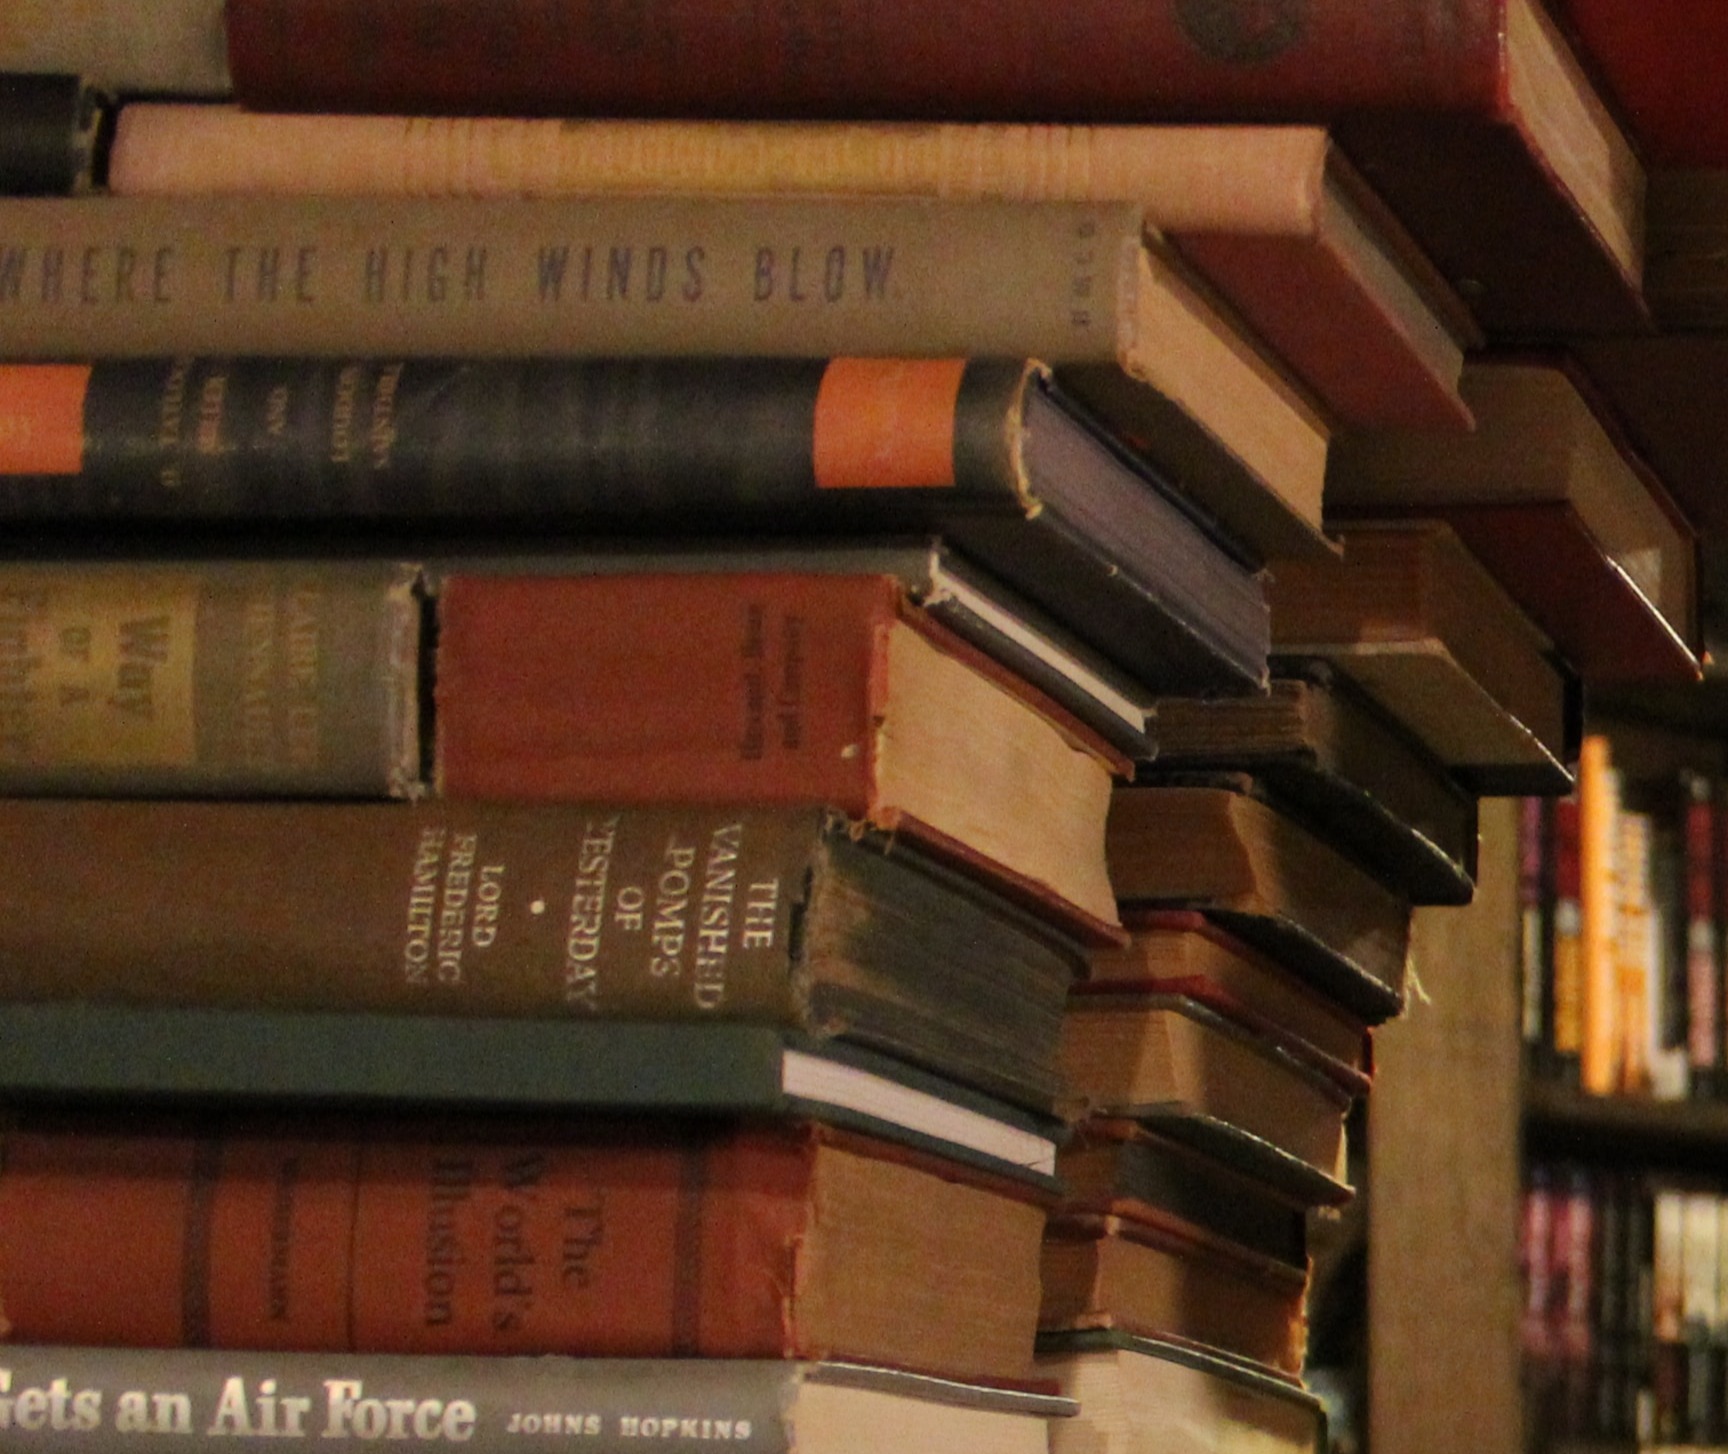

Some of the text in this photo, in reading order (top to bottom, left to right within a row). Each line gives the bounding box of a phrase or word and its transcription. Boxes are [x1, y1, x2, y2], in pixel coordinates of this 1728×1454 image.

[0, 247, 175, 303] WHERE
[225, 247, 318, 303] THE
[364, 247, 488, 303] HIGH
[537, 246, 707, 303] WINDS
[107, 615, 172, 722] Way
[403, 826, 447, 986] HAMILTON
[436, 832, 479, 988] FREDERIC
[471, 864, 506, 949] LORD
[564, 814, 622, 1012] YESTERDAY
[613, 885, 645, 932] OF
[648, 843, 698, 981] POMPS
[692, 821, 745, 1011] VANISHED
[740, 876, 781, 950] THE
[424, 1159, 475, 1327] Illusion
[491, 1155, 546, 1333] World's
[561, 1196, 604, 1290] The
[115, 1391, 195, 1437] an
[206, 1374, 312, 1440] Air
[320, 1377, 476, 1443] Force
[506, 1410, 601, 1437] JOHNS
[619, 1414, 752, 1441] HOPKINS
